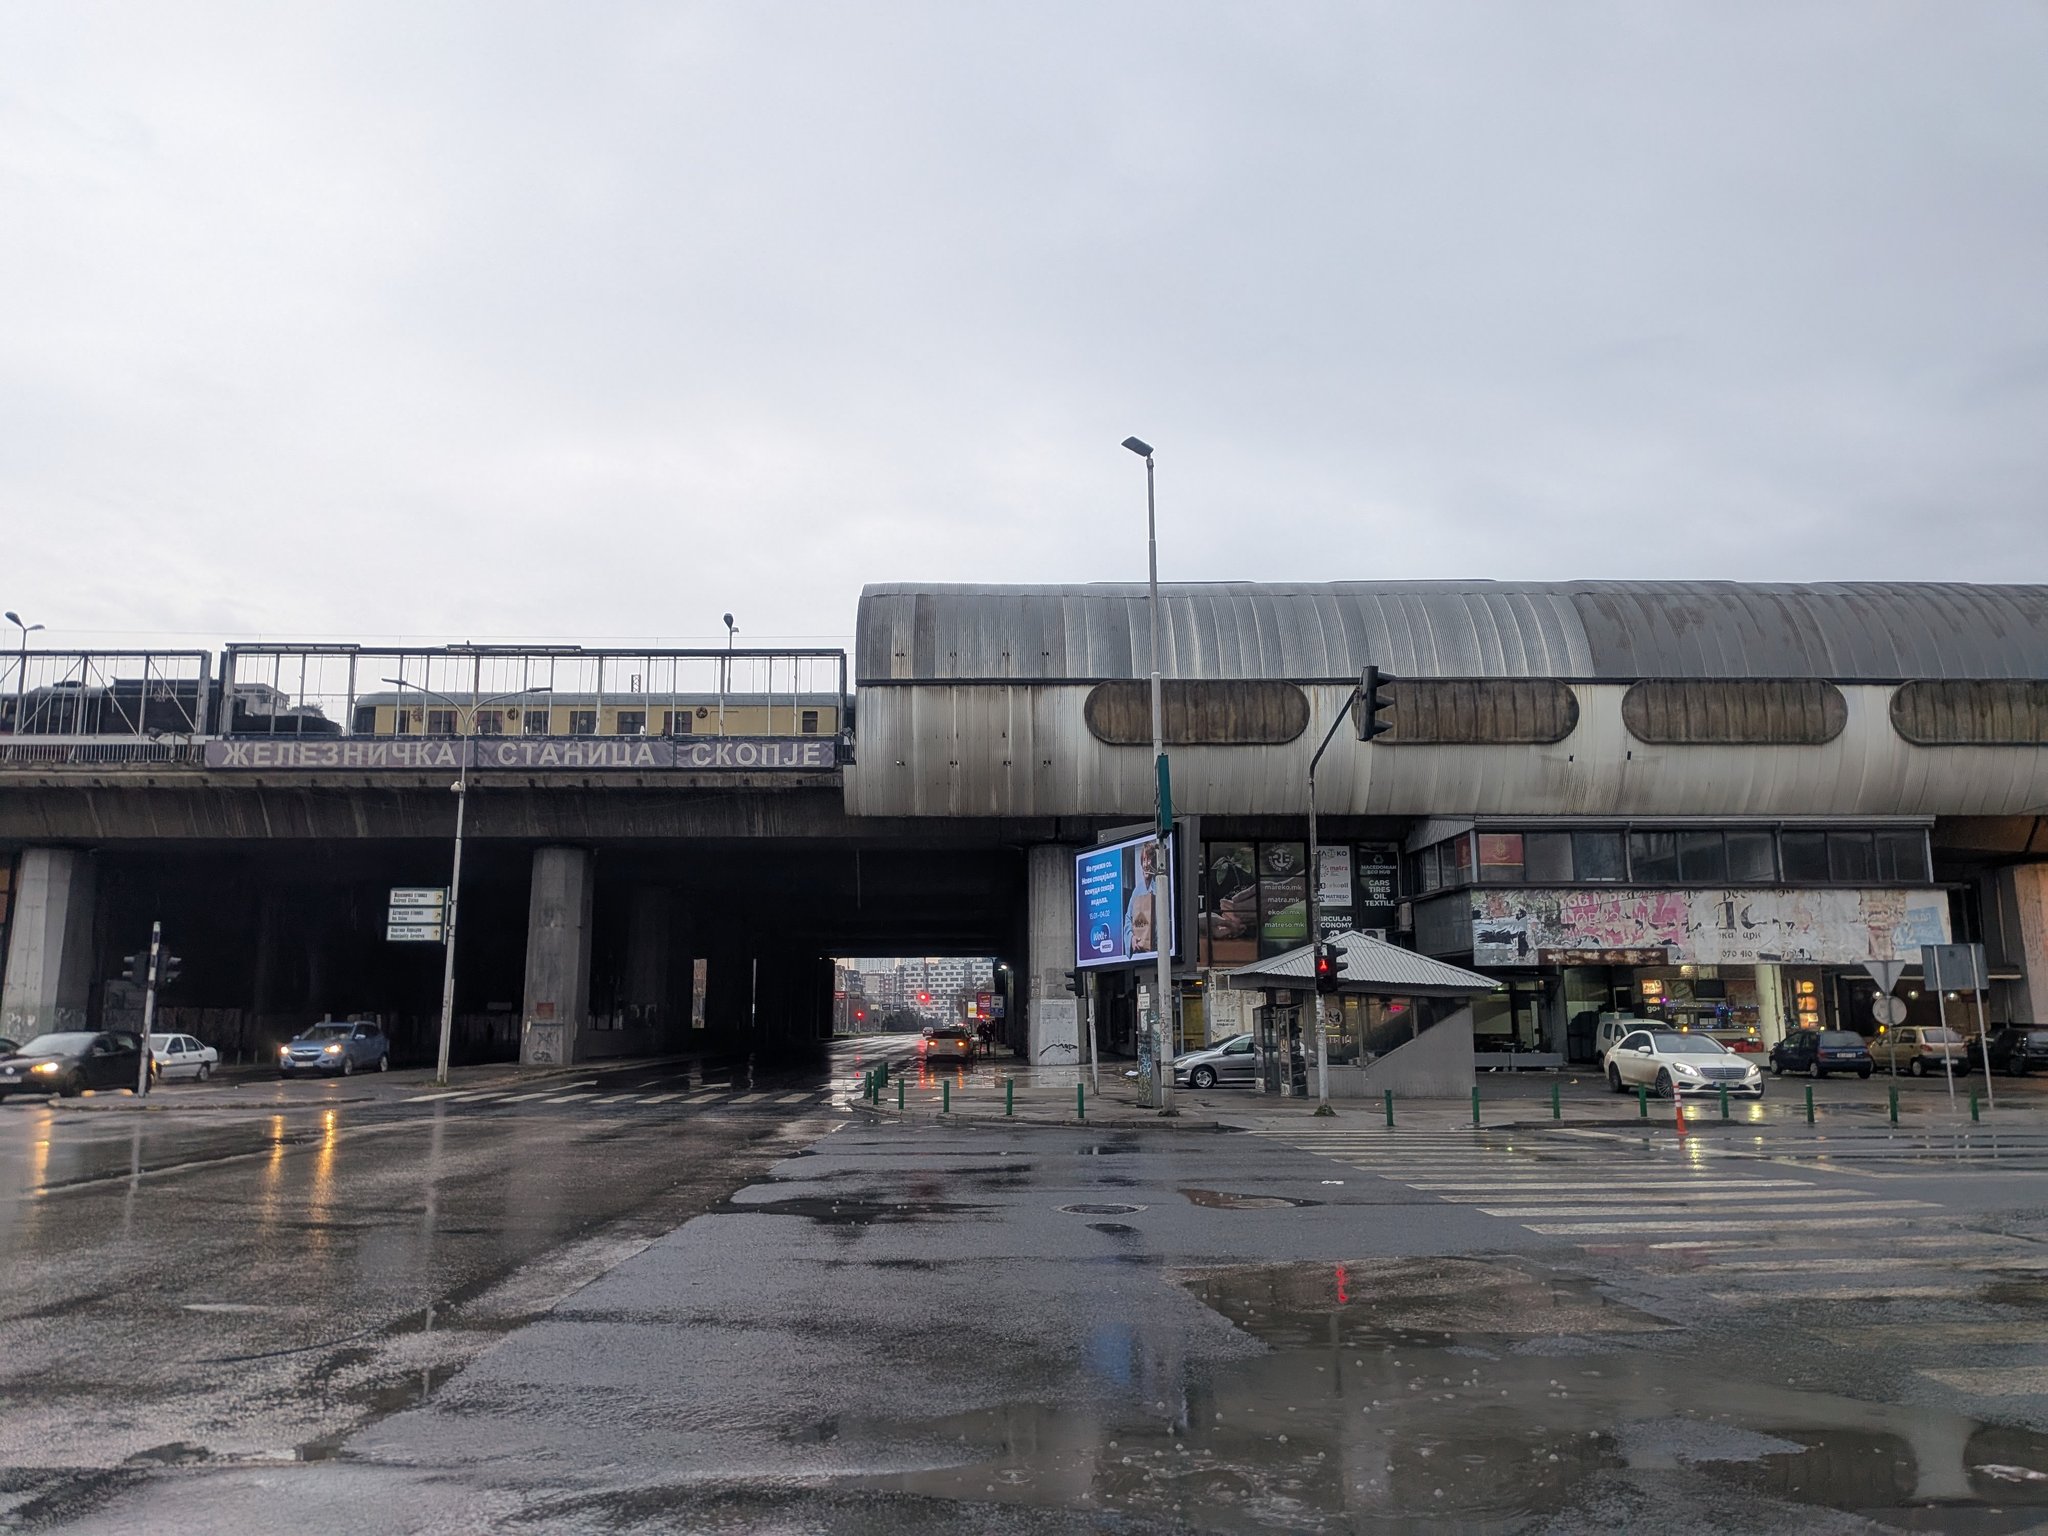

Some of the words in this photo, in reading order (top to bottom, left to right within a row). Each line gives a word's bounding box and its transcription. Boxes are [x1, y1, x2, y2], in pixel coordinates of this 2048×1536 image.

[222, 742, 457, 766] ЖЕЛЕЗНИЧКА
[498, 742, 656, 767] СТАНИЦА
[691, 742, 821, 767] СКОПЈЕ
[1368, 879, 1390, 887] CARS
[1267, 896, 1301, 904] matra.mk
[1722, 950, 1738, 958] 070
